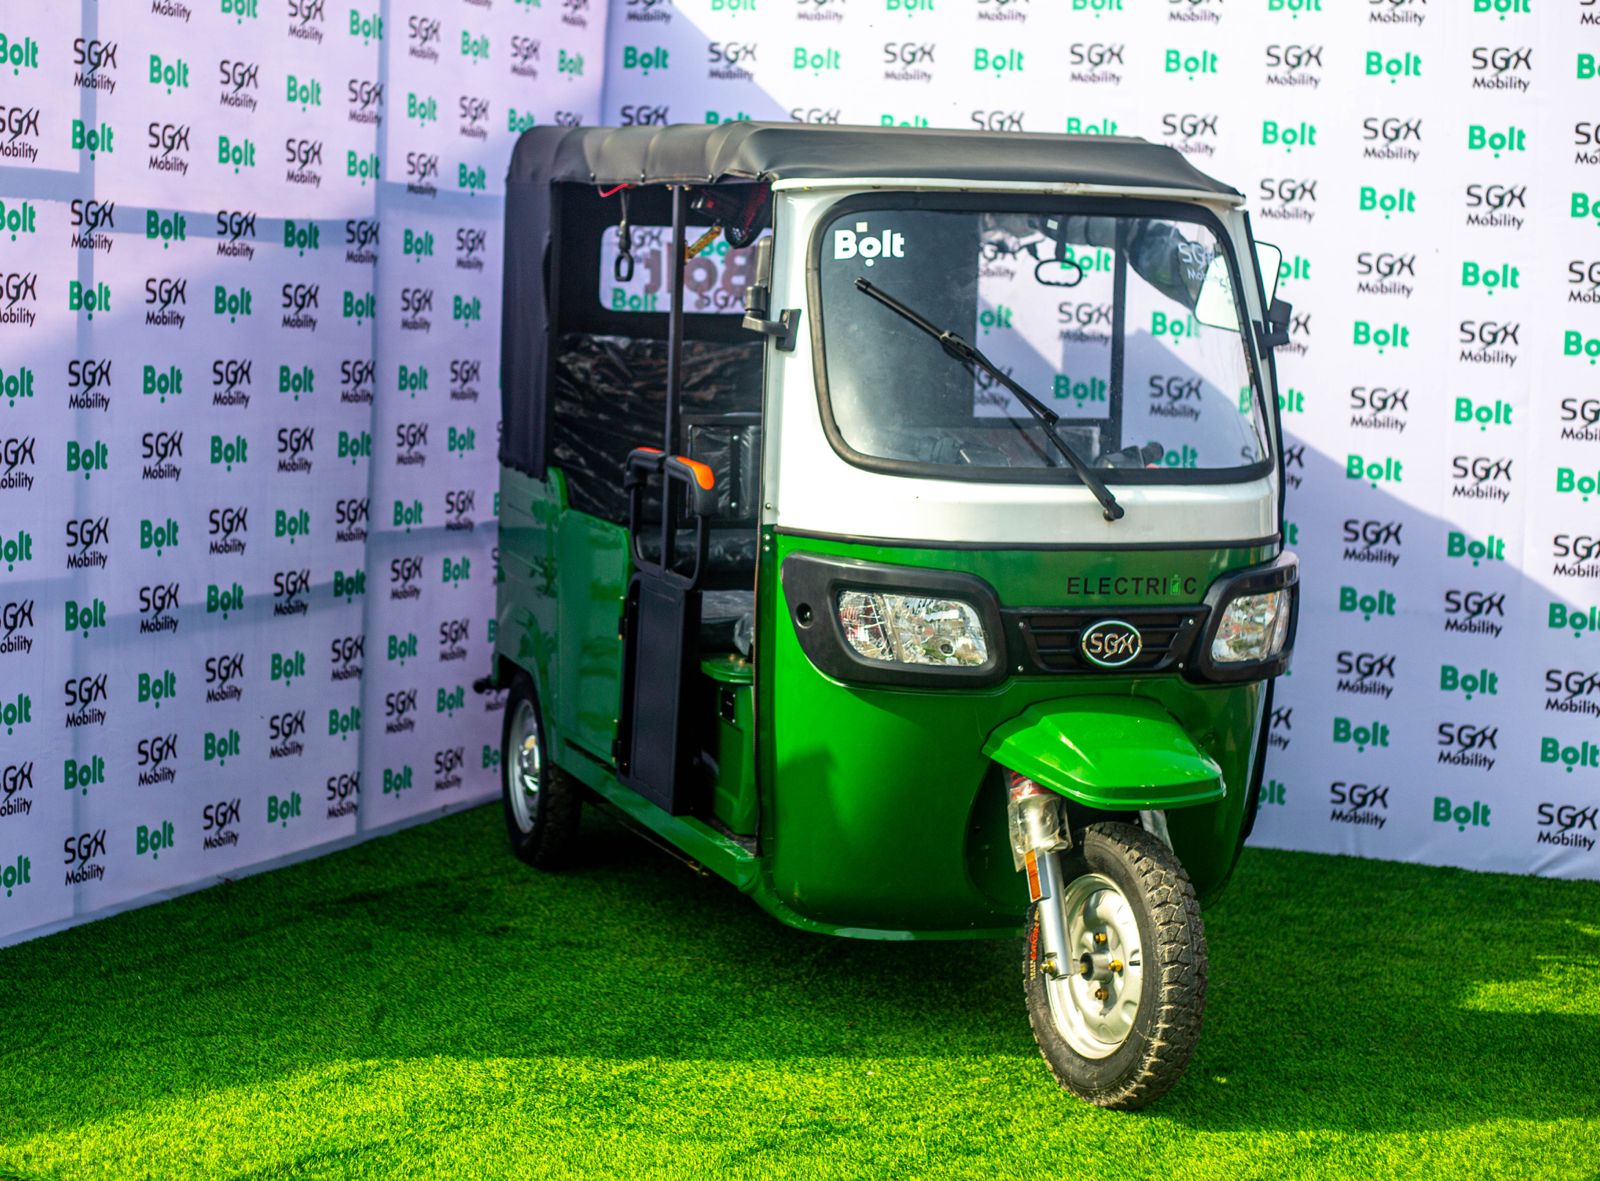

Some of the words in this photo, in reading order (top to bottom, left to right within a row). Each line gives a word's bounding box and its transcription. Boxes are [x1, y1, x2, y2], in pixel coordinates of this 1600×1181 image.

[350, 9, 384, 45] Bolt
[1370, 12, 1425, 25] Mobility
[149, 54, 189, 94] Bolt
[624, 45, 669, 76] Bolt
[794, 47, 840, 76] Bolt
[974, 48, 1024, 78] Bolt
[1165, 49, 1218, 80] Bolt
[1365, 50, 1422, 84] Bolt
[74, 72, 115, 94] Mobility
[287, 75, 320, 111] Bolt
[1268, 75, 1318, 86] Mobility
[1473, 77, 1529, 92] Mobility
[220, 91, 256, 112] Mobility
[408, 92, 436, 126] Bolt
[72, 119, 113, 160] Bolt
[1262, 120, 1316, 153] Bolt
[1468, 124, 1526, 158] Bolt
[149, 154, 188, 176] Mobility
[218, 135, 255, 173] Bolt
[347, 150, 380, 184] Bolt
[1364, 147, 1418, 161] Mobility
[287, 171, 321, 187] Mobility
[458, 162, 486, 196] Bolt
[1262, 208, 1312, 222] Mobility
[1360, 186, 1416, 220] Bolt
[146, 209, 186, 249] Bolt
[1467, 214, 1523, 230] Mobility
[71, 233, 113, 253] Mobility
[217, 243, 254, 261] Mobility
[283, 220, 320, 256] Bolt
[403, 228, 433, 262] Bolt
[834, 229, 904, 267] Bolt
[345, 251, 378, 269] Mobility
[1358, 283, 1412, 297] Mobility
[1462, 261, 1520, 295] Bolt
[69, 280, 110, 320] Bolt
[214, 285, 251, 322] Bolt
[344, 290, 375, 322] Bolt
[453, 295, 480, 326] Bolt
[612, 287, 657, 311] Bolt
[145, 310, 185, 329] Mobility
[282, 314, 317, 331] Mobility
[1353, 320, 1409, 354] Bolt
[1460, 350, 1516, 367] Mobility
[143, 365, 182, 403] Bolt
[279, 365, 313, 400] Bolt
[399, 365, 427, 397] Bolt
[1054, 374, 1107, 408] Bolt
[69, 392, 110, 412] Mobility
[213, 390, 250, 408] Mobility
[341, 390, 376, 408] Mobility
[1150, 404, 1201, 422] Mobility
[1455, 397, 1513, 431] Bolt
[1351, 416, 1406, 432] Mobility
[210, 435, 247, 471] Bolt
[338, 432, 371, 464] Bolt
[448, 428, 474, 457] Bolt
[67, 441, 108, 480] Bolt
[142, 463, 181, 482] Mobility
[277, 457, 312, 474] Mobility
[1346, 454, 1402, 489] Bolt
[1453, 485, 1509, 502] Mobility
[274, 509, 309, 544] Bolt
[394, 500, 424, 531] Bolt
[140, 518, 179, 557] Bolt
[209, 539, 246, 555] Mobility
[1447, 531, 1505, 568] Bolt
[67, 551, 108, 570] Mobility
[1343, 548, 1399, 567] Mobility
[334, 567, 365, 602] Bolt
[207, 584, 243, 620] Bolt
[273, 599, 308, 616] Mobility
[1339, 585, 1396, 622] Bolt
[65, 599, 105, 639] Bolt
[140, 615, 179, 634] Mobility
[1445, 618, 1502, 638] Mobility
[388, 635, 416, 666] Bolt
[271, 652, 304, 684] Bolt
[1440, 665, 1498, 701] Bolt
[138, 671, 175, 708] Bolt
[206, 685, 242, 703] Mobility
[1337, 679, 1393, 699] Mobility
[66, 708, 106, 728] Mobility
[329, 706, 361, 740] Bolt
[204, 730, 239, 766] Bolt
[269, 741, 304, 759] Mobility
[1333, 717, 1389, 752] Bolt
[1438, 750, 1495, 771] Mobility
[1540, 737, 1600, 773] Bolt
[64, 756, 104, 794] Bolt
[138, 767, 176, 787] Mobility
[268, 793, 300, 828] Bolt
[1330, 809, 1386, 830] Mobility
[1433, 796, 1491, 832] Bolt
[136, 822, 173, 855] Bolt
[203, 830, 239, 850] Mobility
[1537, 830, 1596, 851] Mobility
[65, 864, 105, 886] Mobility
